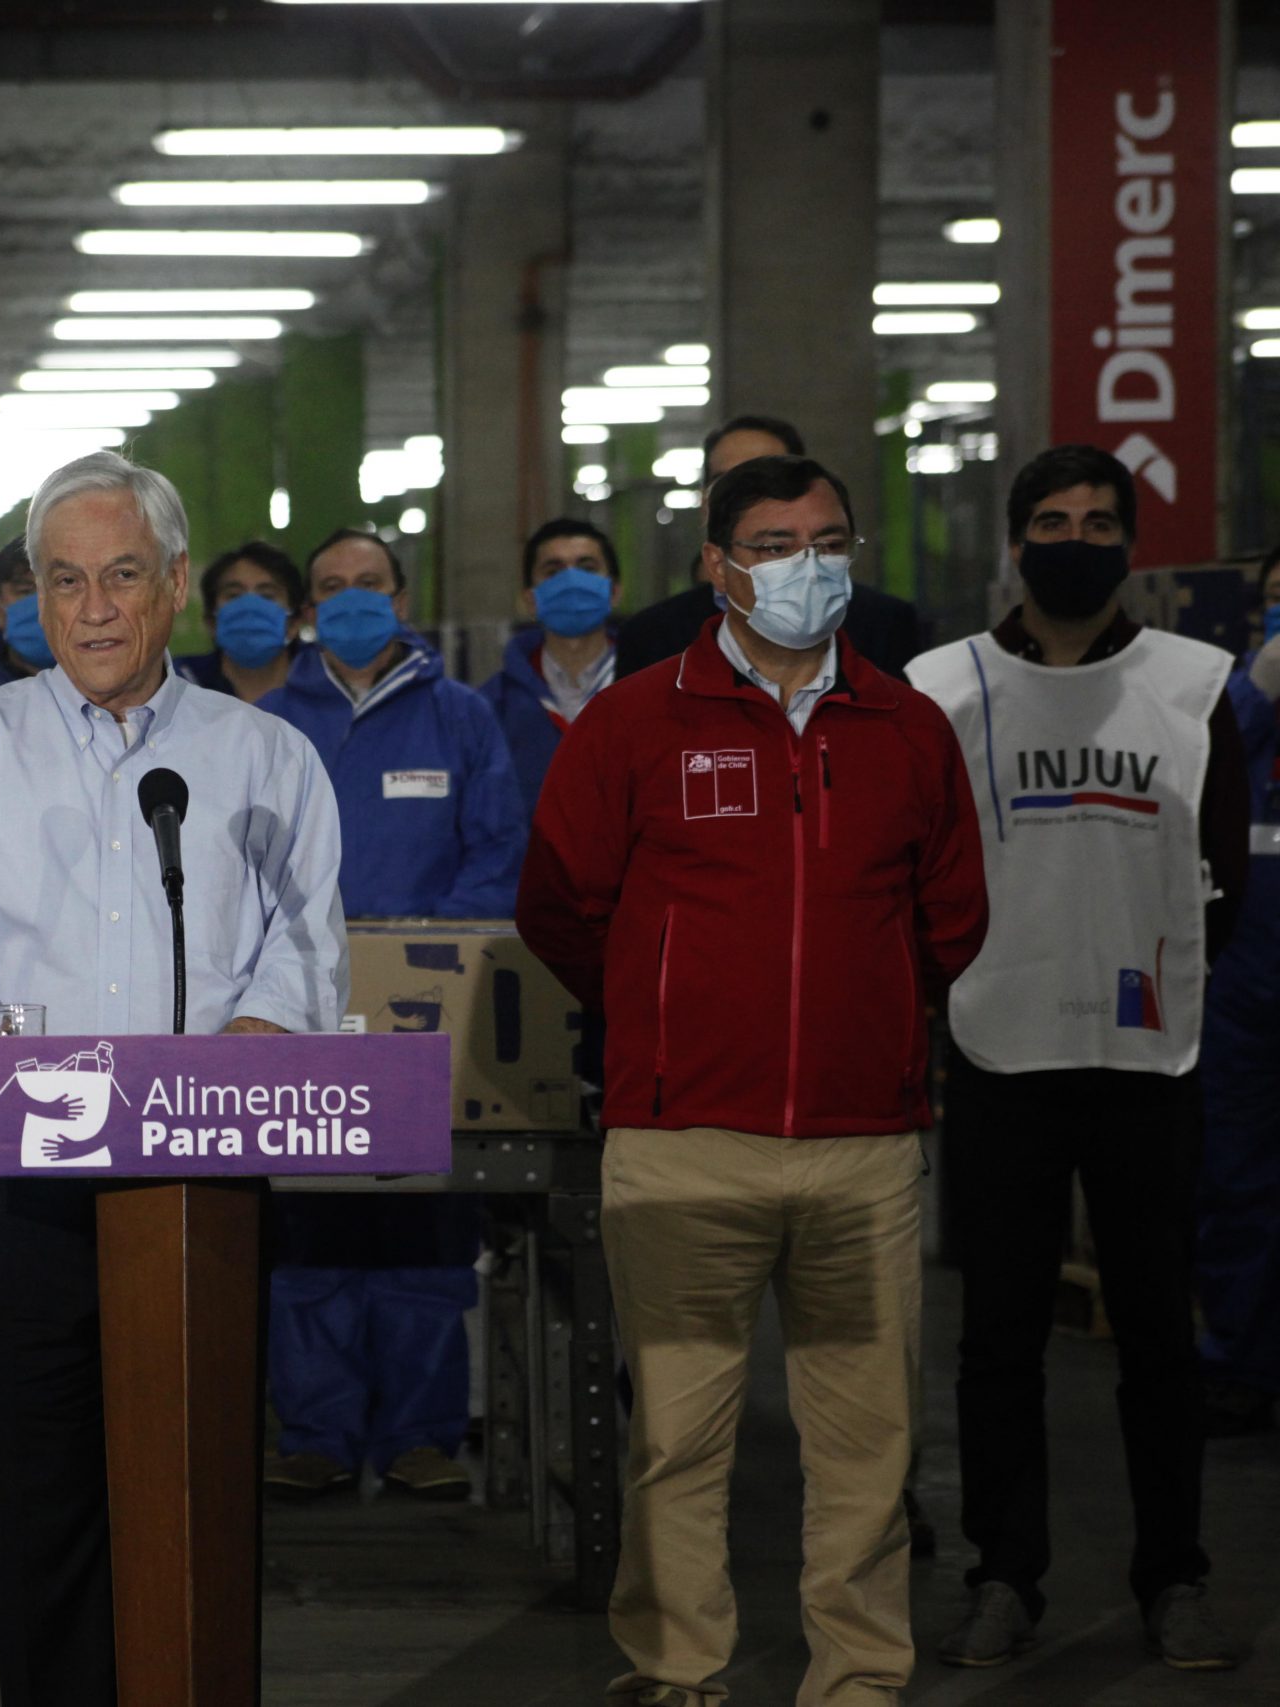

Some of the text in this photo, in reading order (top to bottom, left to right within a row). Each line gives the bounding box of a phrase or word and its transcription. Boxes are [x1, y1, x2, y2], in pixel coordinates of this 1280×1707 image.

[1091, 90, 1176, 424] Dimerc
[1017, 747, 1159, 793] INJUV
[142, 1075, 371, 1116] Alimentos
[142, 1118, 371, 1156] Para Chile
